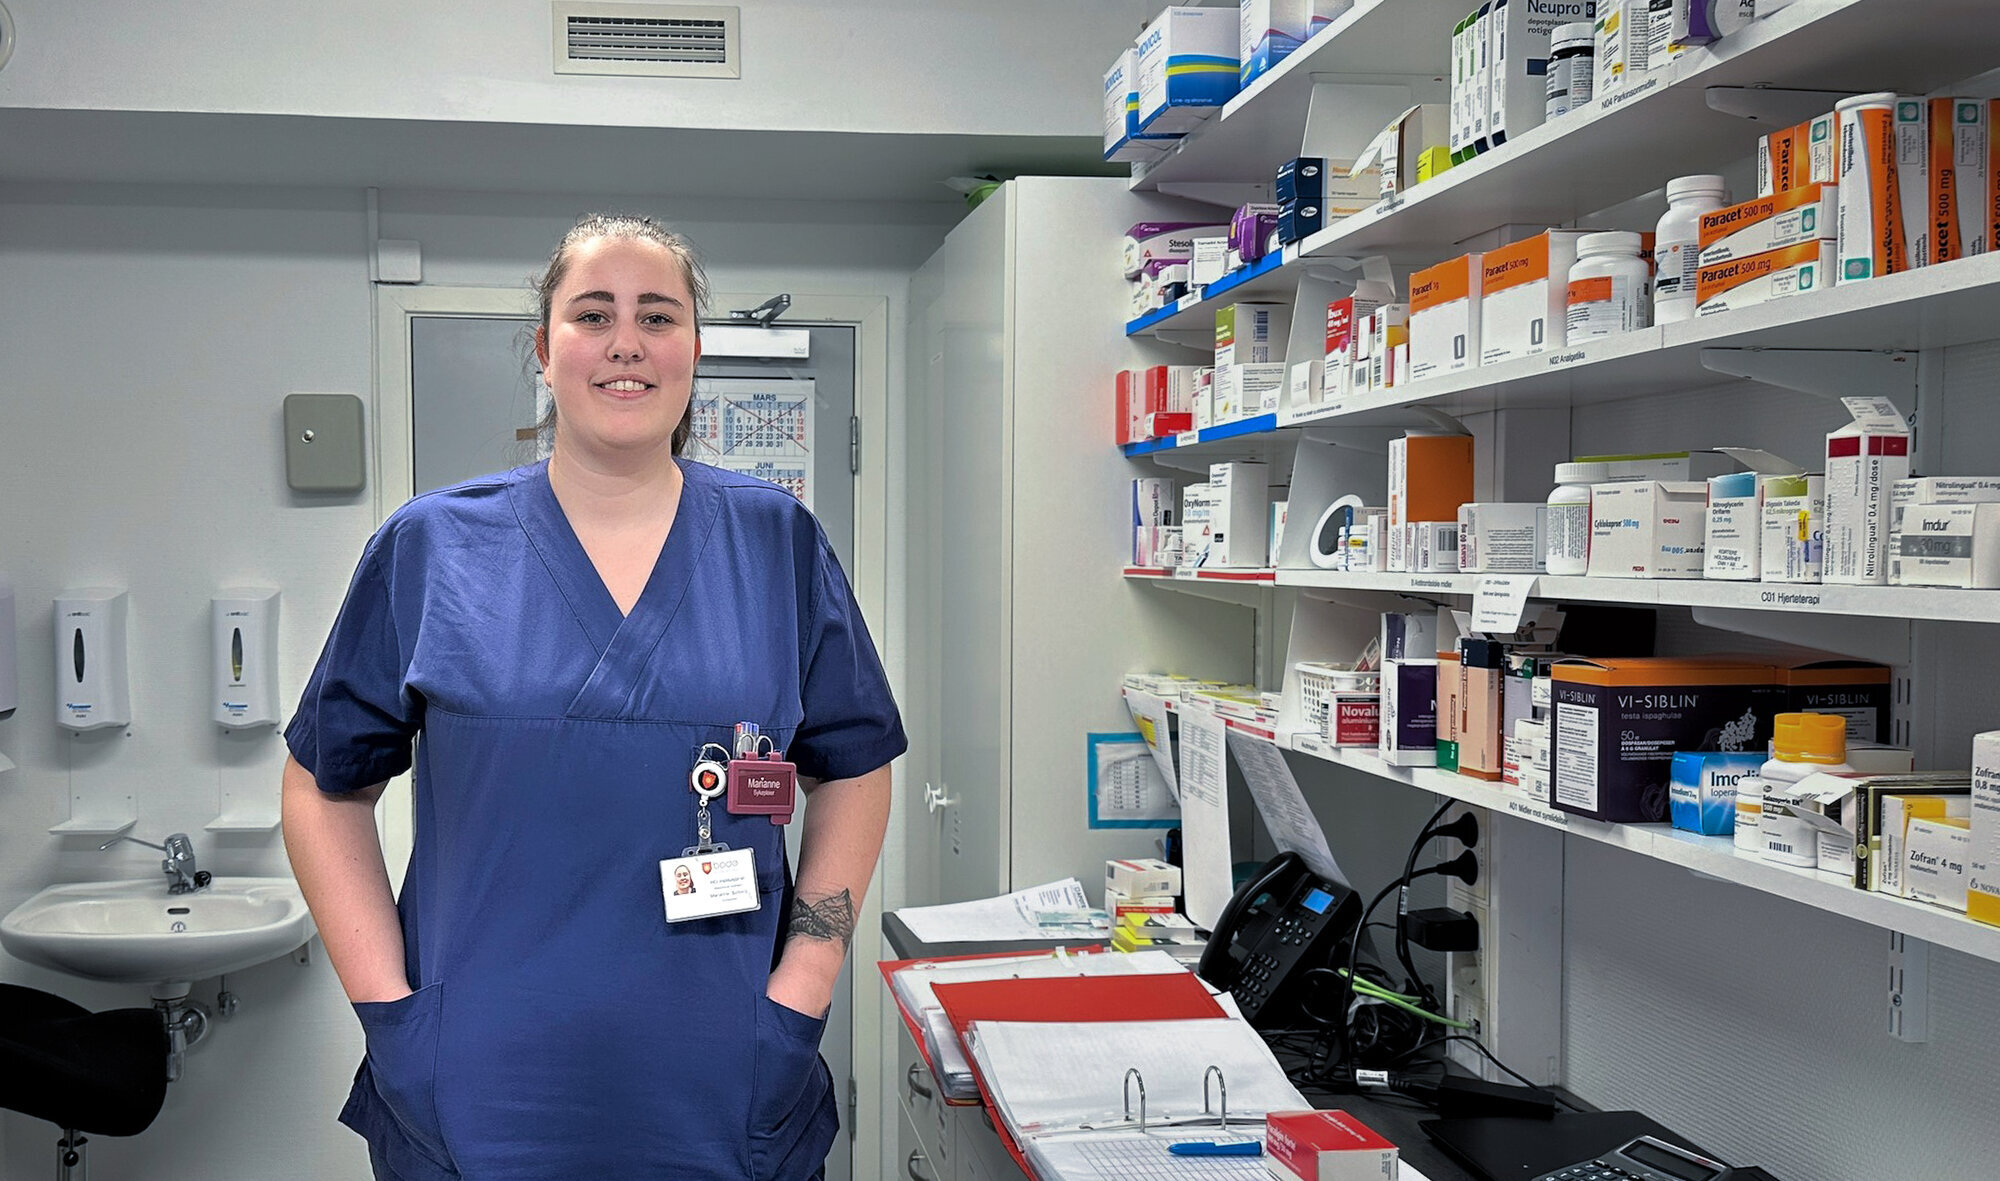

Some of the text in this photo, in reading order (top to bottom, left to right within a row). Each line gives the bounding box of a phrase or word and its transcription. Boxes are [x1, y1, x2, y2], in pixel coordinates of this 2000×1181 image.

[1527, 0, 1580, 17] Neupro
[1940, 169, 1953, 190] mg
[1938, 194, 1950, 216] 500
[1703, 202, 1774, 229] Paracet 500 mg
[1485, 261, 1508, 278] Paracet
[1701, 259, 1771, 284] Paracet 500 mg
[1412, 280, 1432, 297] Paracet
[1560, 351, 1585, 364] Analgetika
[1867, 459, 1879, 502] mg/dose
[1184, 499, 1210, 508] OxyNorm
[1867, 503, 1878, 518] 0.4
[1622, 519, 1632, 527] 500
[1632, 520, 1639, 529] mg
[1922, 519, 1949, 532] Imdur
[1460, 524, 1468, 569] Lixiana 60 mg
[1661, 545, 1683, 554] 500 mg
[1921, 539, 1951, 554] 30 mg
[1761, 592, 1820, 604] C01 Hjerteterapi
[1559, 690, 1595, 704] VI-SIBLIN
[1618, 695, 1697, 708] VI-SIBLIN
[1806, 694, 1869, 705] VI-SIBLIN
[1642, 712, 1682, 720] ispaghulae
[1621, 730, 1634, 740] 50
[748, 777, 780, 788] Marianne
[1910, 850, 1963, 875] Zofran 4 mg
